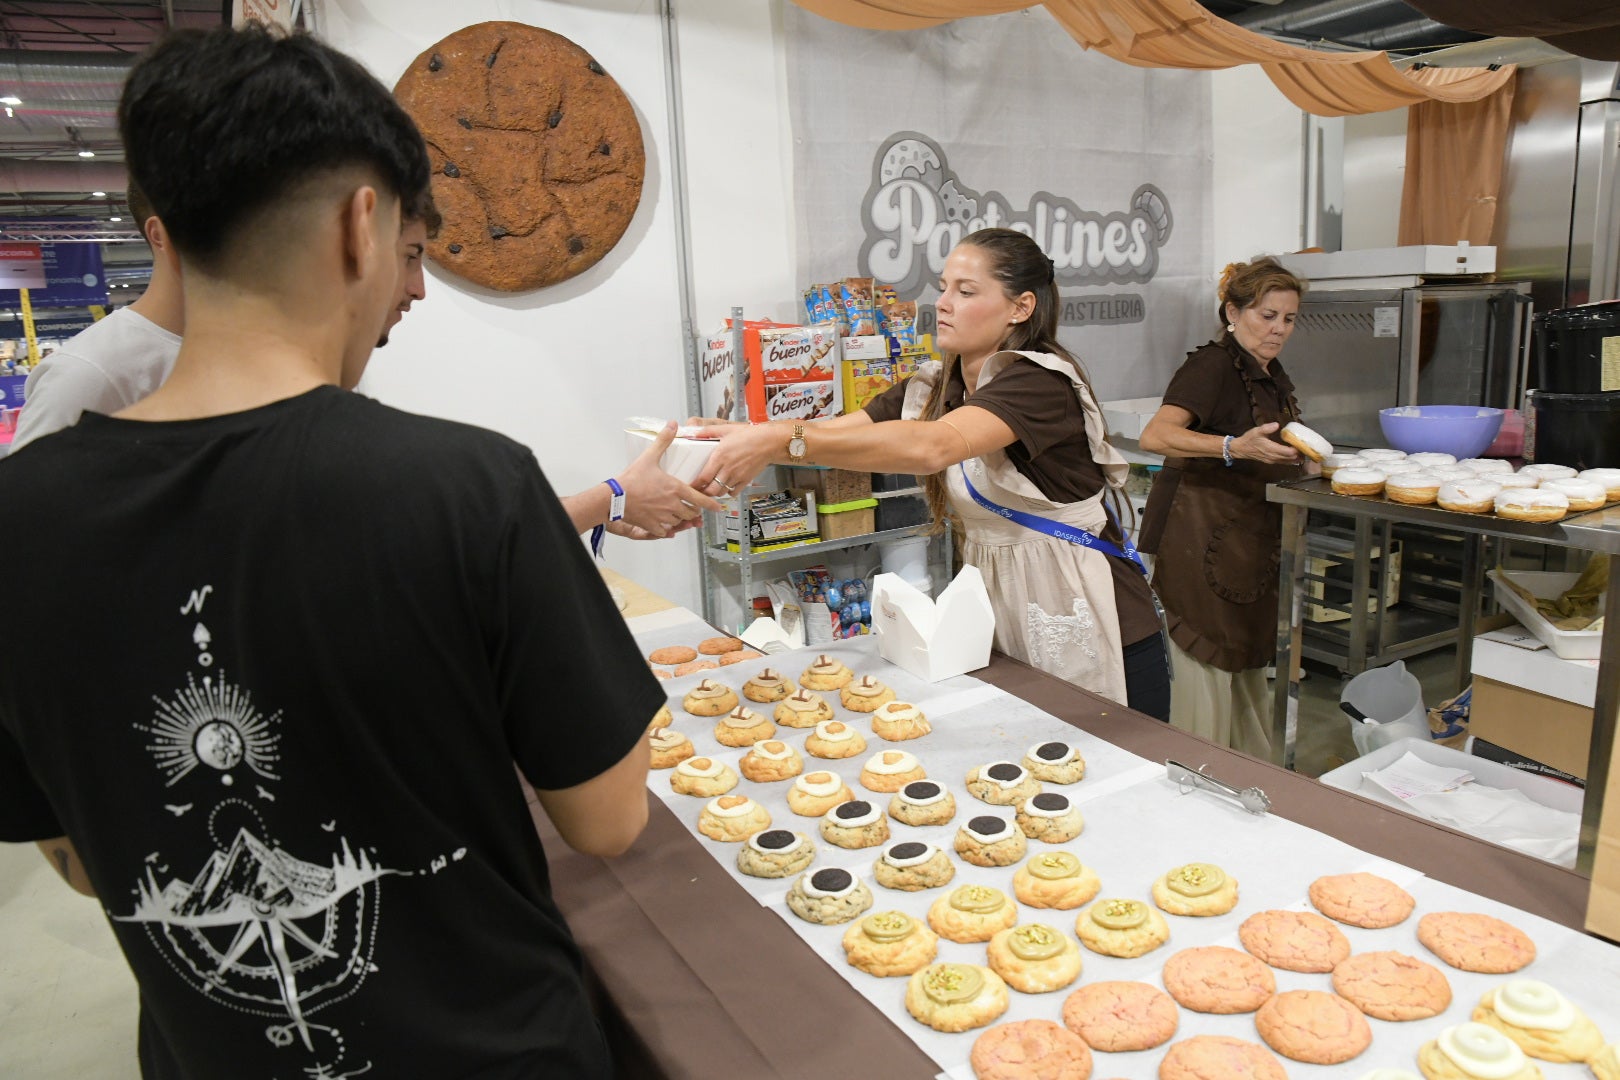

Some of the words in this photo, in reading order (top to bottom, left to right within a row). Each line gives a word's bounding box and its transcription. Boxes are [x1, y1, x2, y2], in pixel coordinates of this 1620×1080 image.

[868, 179, 1147, 283] Palines
[1060, 300, 1142, 322] ASTELERIA
[769, 344, 811, 362] bueno
[772, 395, 814, 416] bueno
[1053, 529, 1086, 545] IDASFEST
[180, 584, 213, 615] N
